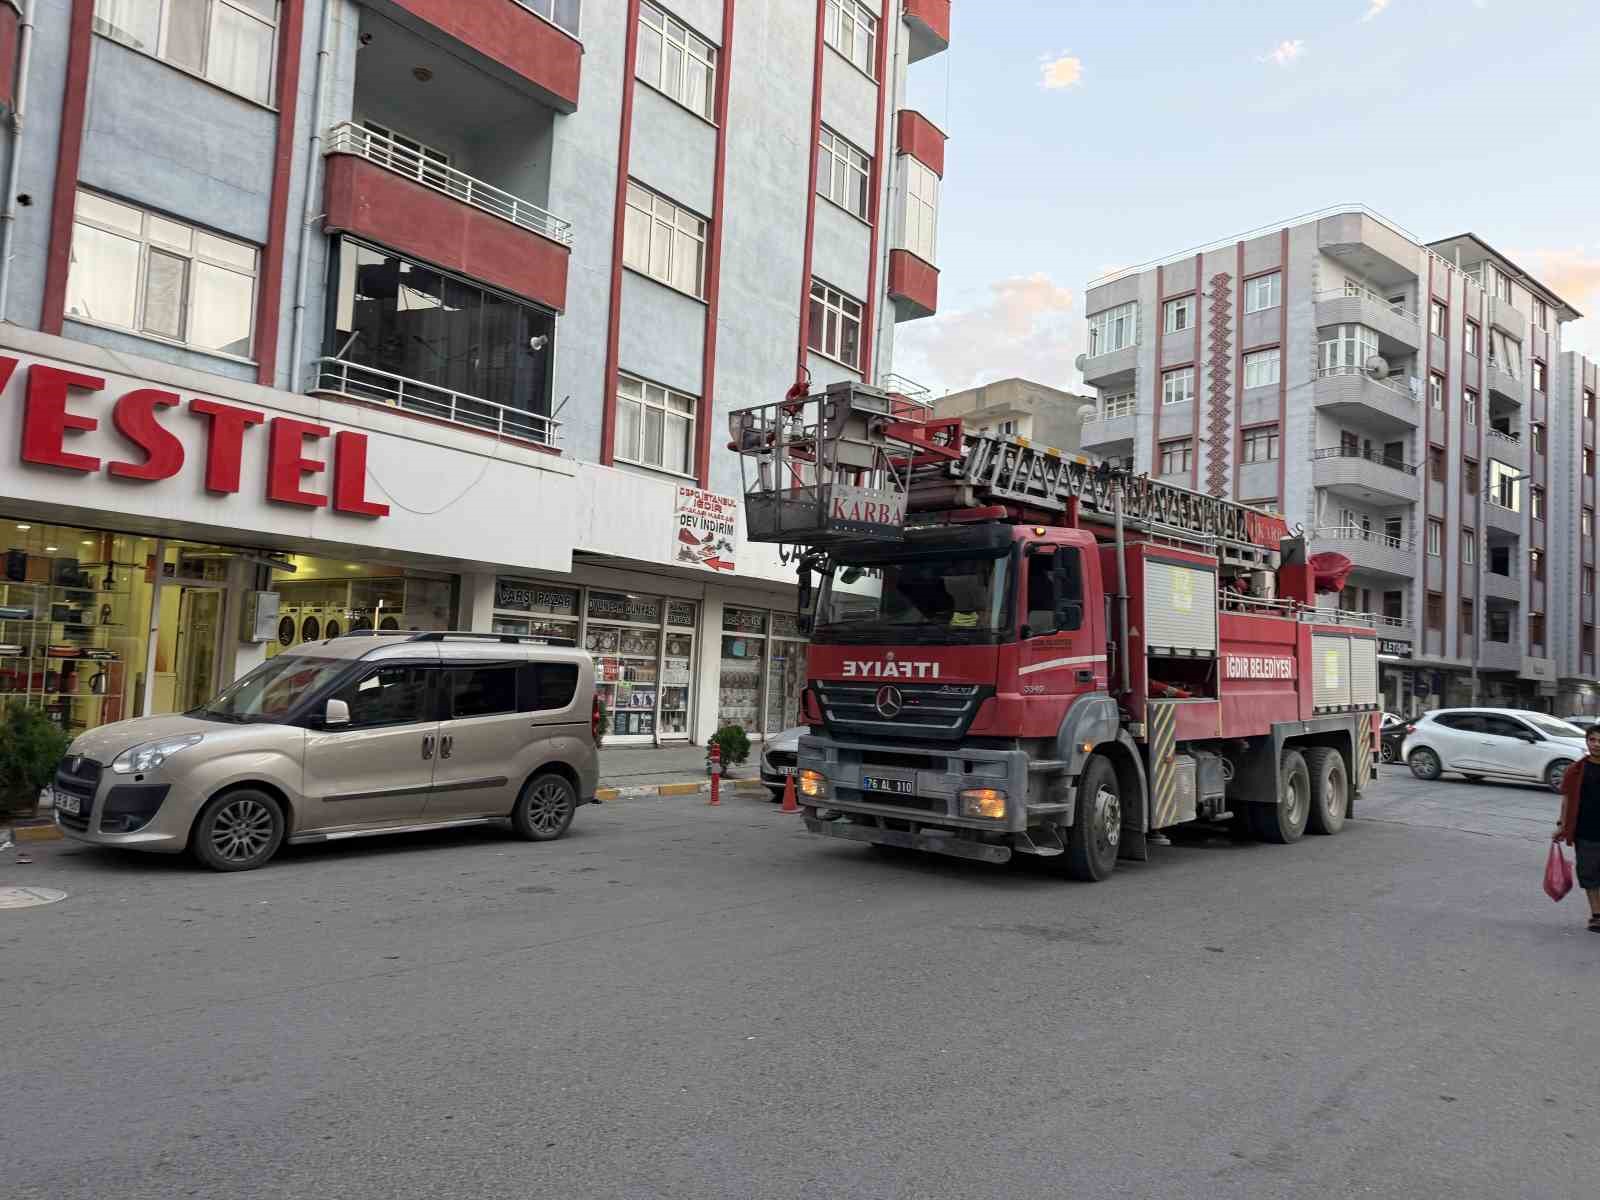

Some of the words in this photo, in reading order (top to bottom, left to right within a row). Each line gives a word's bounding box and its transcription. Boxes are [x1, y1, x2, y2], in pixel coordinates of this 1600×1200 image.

[0, 356, 390, 517] ESTEL
[680, 513, 698, 528] DEV
[700, 516, 734, 536] İNDİRİM
[832, 497, 902, 526] KARBA
[896, 781, 912, 793] 110
